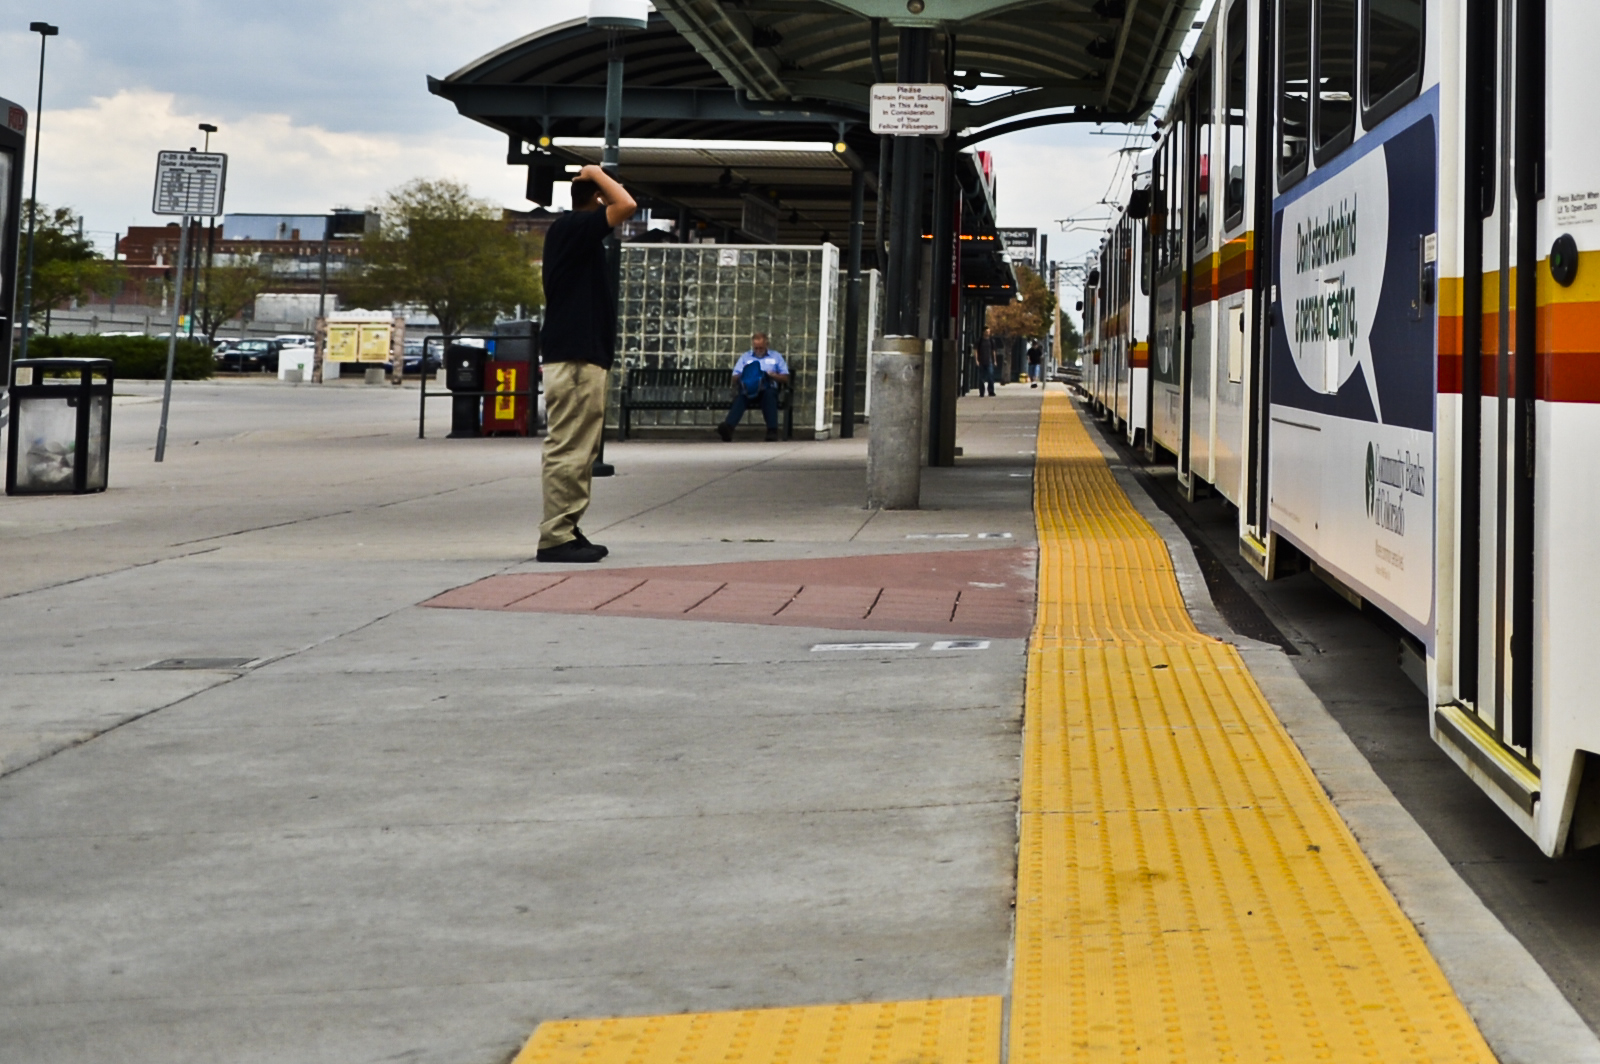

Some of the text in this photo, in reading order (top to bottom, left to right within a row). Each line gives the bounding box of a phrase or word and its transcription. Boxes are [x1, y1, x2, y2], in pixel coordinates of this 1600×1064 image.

[187, 154, 219, 162] Broadway
[1312, 206, 1330, 270] stand
[1331, 191, 1357, 263] behind
[1300, 294, 1324, 359] person
[1406, 450, 1425, 497] Banks
